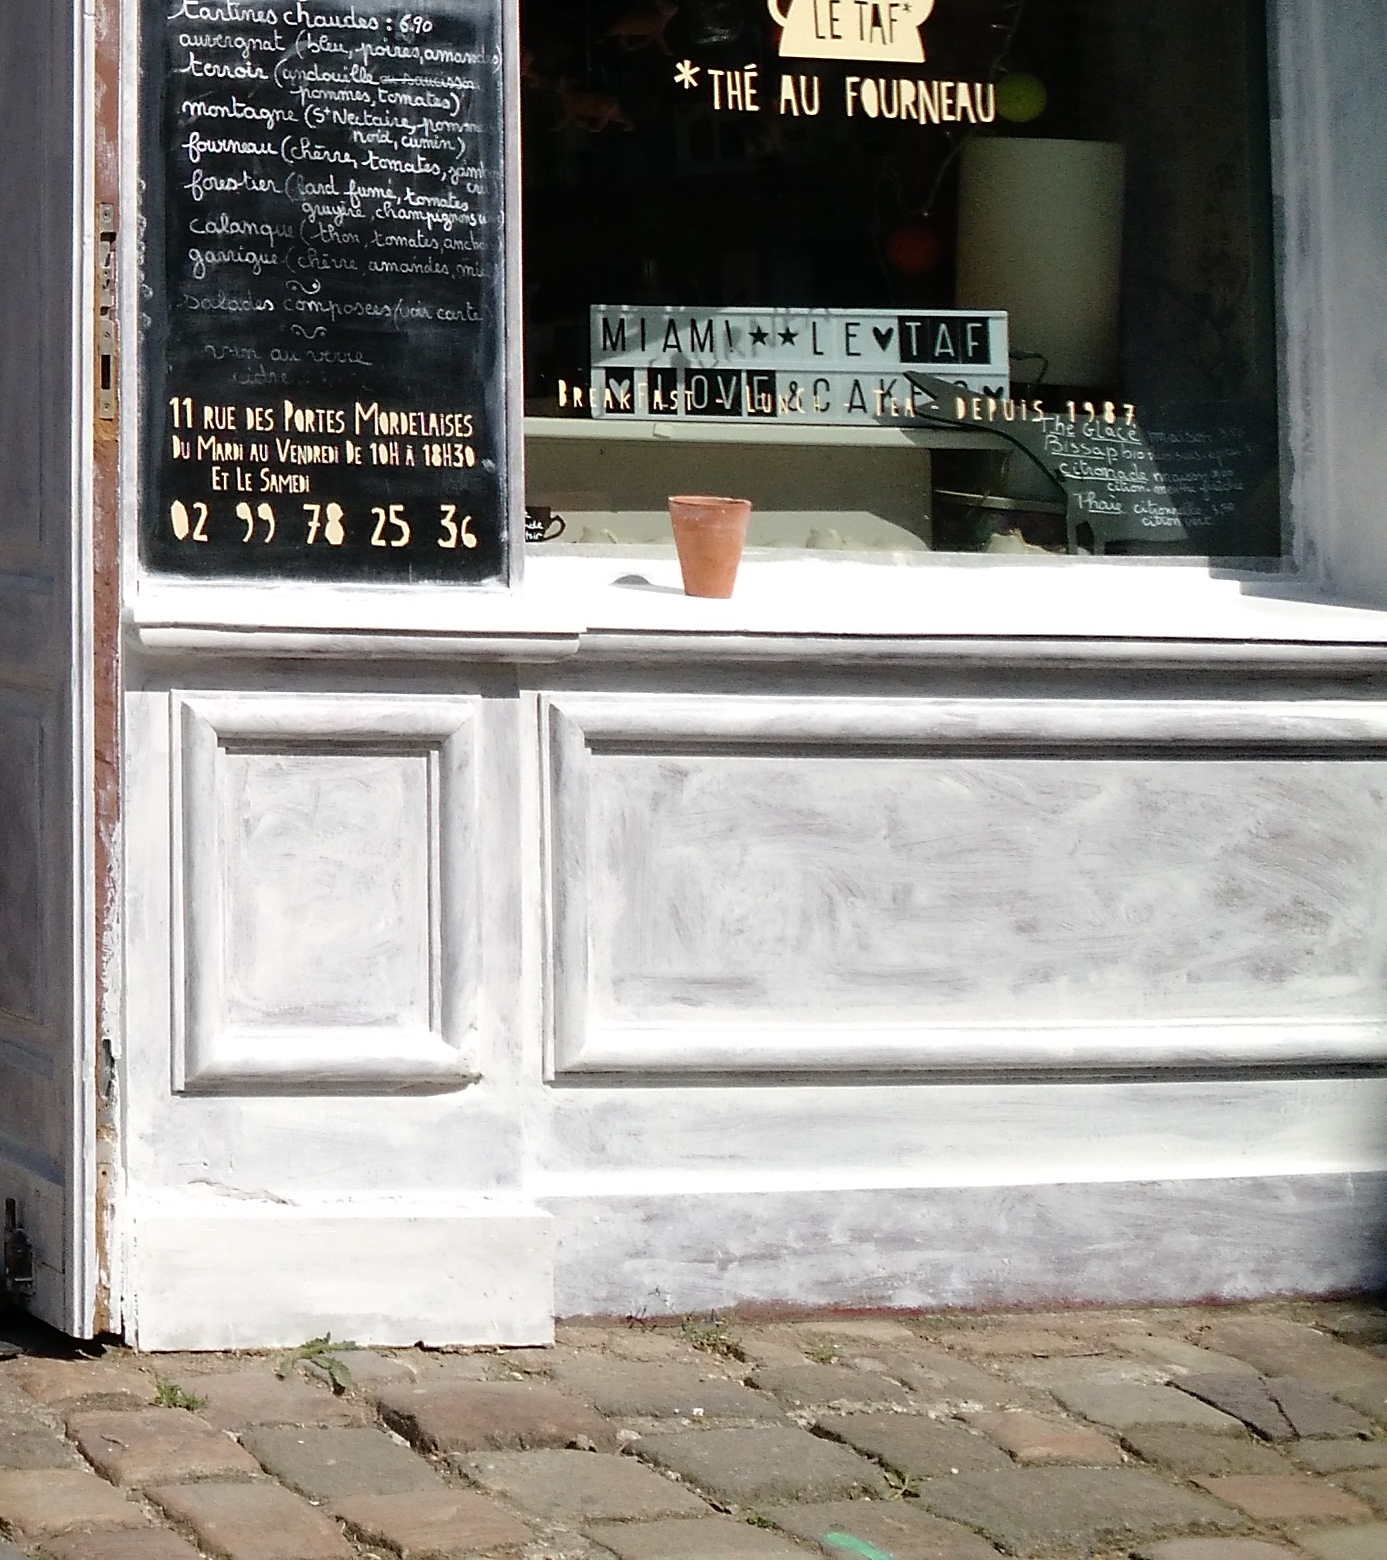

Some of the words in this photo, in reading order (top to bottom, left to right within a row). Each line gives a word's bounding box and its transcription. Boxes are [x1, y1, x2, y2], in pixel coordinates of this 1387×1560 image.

[284, 1, 378, 31] chaudes
[179, 30, 286, 58] auvergnat
[173, 53, 269, 79] terroir
[182, 99, 298, 131] montagne
[780, 75, 820, 117] AU
[846, 76, 995, 125] FOURNEAU
[181, 132, 279, 162] fourneau
[184, 170, 286, 201] forestier
[813, 322, 861, 356] LE
[905, 322, 982, 357] TAF
[169, 397, 193, 430] 11
[203, 406, 235, 431] RUE
[247, 407, 274, 432] DES
[284, 400, 345, 434] PORTES
[355, 402, 473, 438] MORDELAISES
[1066, 401, 1136, 425] 1987
[172, 435, 190, 459] DU
[197, 436, 243, 461] MARDI
[250, 442, 269, 462] AU
[276, 438, 339, 465] VENDREDI
[346, 442, 362, 465] DE
[372, 443, 399, 466] 10H
[423, 444, 475, 467] 18H30
[212, 467, 229, 491] ET
[236, 467, 252, 492] LE
[259, 467, 311, 494] SAMEDI
[170, 500, 208, 541] 02
[236, 503, 275, 543] 99
[303, 503, 344, 545] 78
[371, 505, 410, 547] 25
[438, 505, 477, 549] 36
